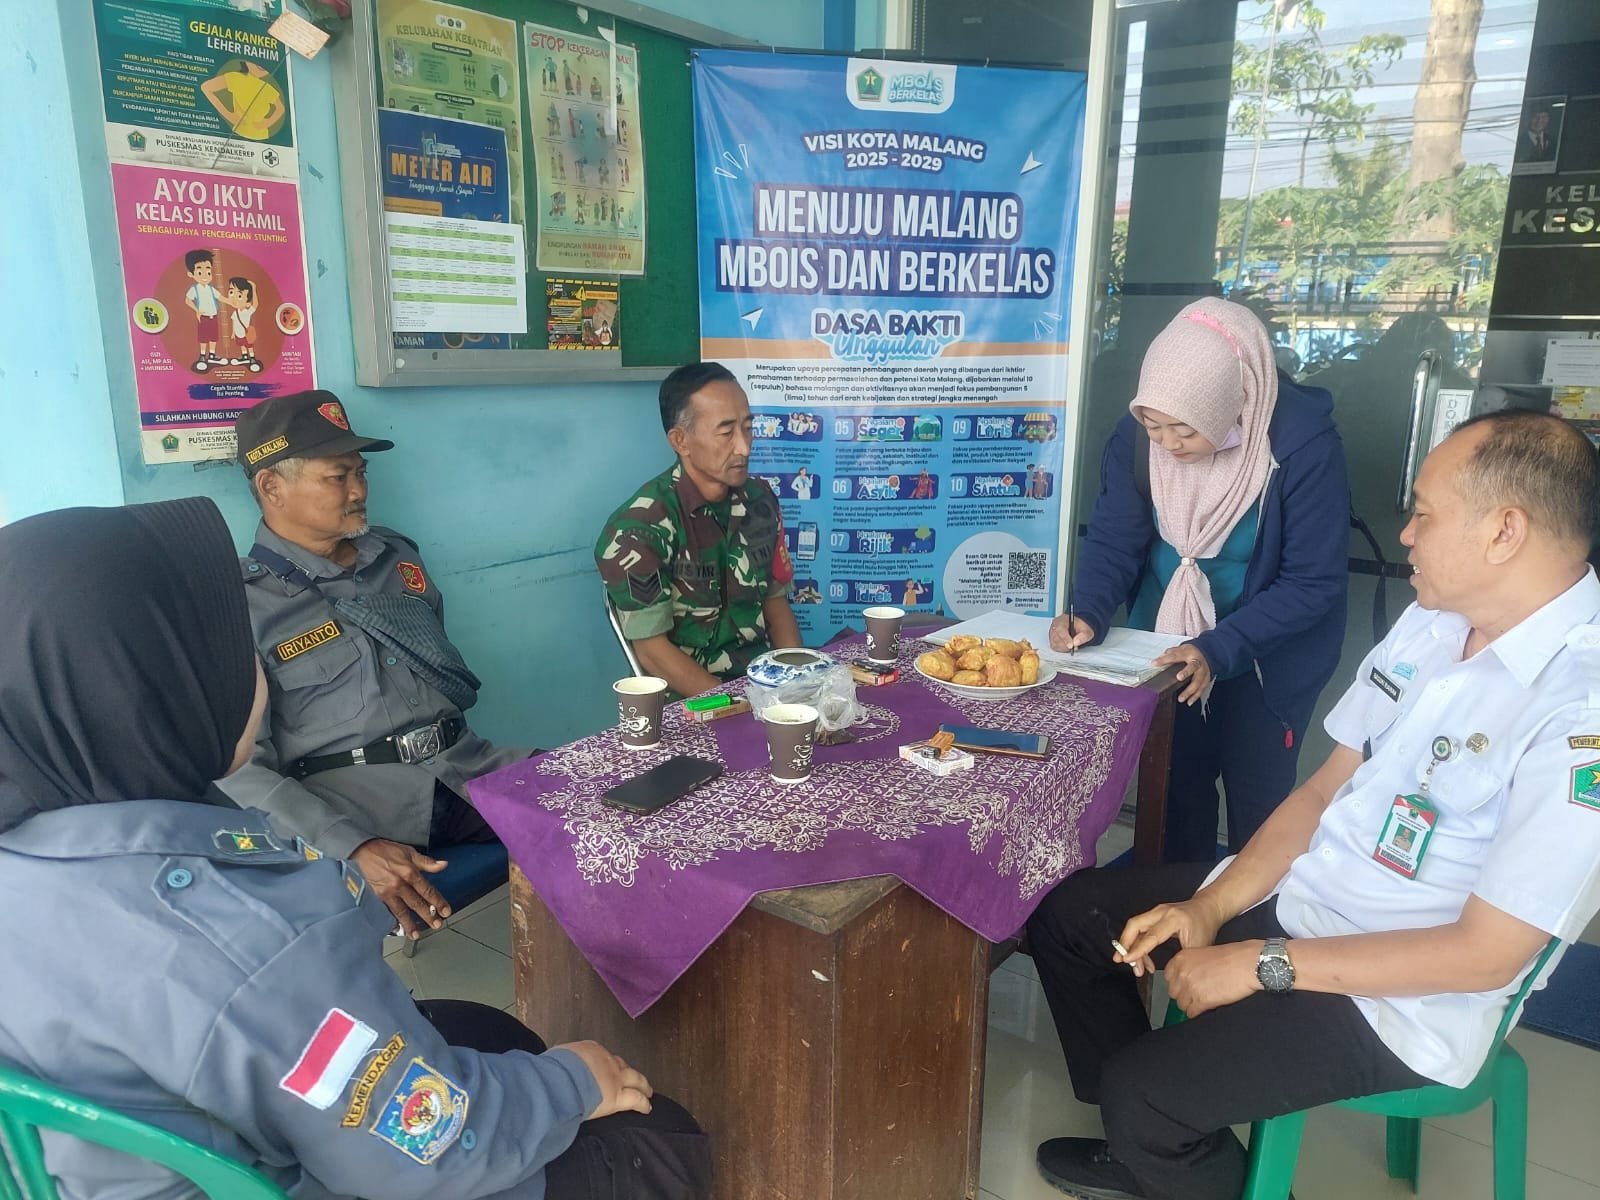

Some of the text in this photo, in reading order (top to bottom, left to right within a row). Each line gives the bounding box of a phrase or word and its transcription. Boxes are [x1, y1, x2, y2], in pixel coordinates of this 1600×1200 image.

[189, 20, 232, 39] GEJALA
[235, 30, 278, 50] KANKER
[395, 24, 453, 40] KELURAHAN
[207, 37, 279, 62] LEHER RAHIM
[530, 32, 565, 52] STOP
[891, 71, 944, 92] MBOIS
[889, 89, 944, 104] BERKELAS
[156, 139, 202, 152] PUSKESMAS
[804, 132, 984, 160] VISI KOTA MALANG
[391, 152, 492, 188] METER AIR
[846, 152, 888, 168] 2025
[900, 154, 943, 171] 2029
[153, 177, 267, 211] AYO IKUT
[1544, 184, 1600, 203] KEL
[135, 202, 286, 231] KELAS IBU HAMIL
[758, 189, 1018, 240] MENUJU MALANG
[1511, 206, 1600, 234] KES
[137, 224, 288, 243] SEBAGAI UPAYA PENCEGAHAN STUNTING
[719, 244, 1052, 294] MBOIS DAN BERKELAS
[814, 312, 961, 336] DASA BAKTI
[833, 331, 941, 362] Unggulan
[756, 364, 796, 372] Merupakan
[820, 366, 862, 374] percepatan
[862, 366, 913, 374] pembangunan
[958, 366, 990, 374] dibangun
[748, 374, 792, 382] pemahaman
[966, 376, 1001, 384] dijabarkan
[750, 382, 785, 392] (sepuluh)
[785, 384, 813, 392] bahasa
[784, 392, 806, 402] (lima)
[862, 395, 896, 403] kebijakan
[938, 395, 962, 403] jangka
[155, 413, 192, 422] SILAHKAN
[192, 412, 226, 421] HUBUNGI
[834, 420, 849, 435] 05
[857, 424, 904, 440] Seger
[952, 421, 966, 434] 09
[188, 436, 232, 445] PUSKESMAS
[249, 438, 286, 462] KOTA MALANG
[832, 480, 847, 494] 06
[951, 478, 963, 492] 10
[830, 534, 845, 547] 07
[830, 584, 844, 598] 08
[281, 623, 336, 660] IRIYANTO
[346, 1039, 402, 1124] KEMENDAGRI
